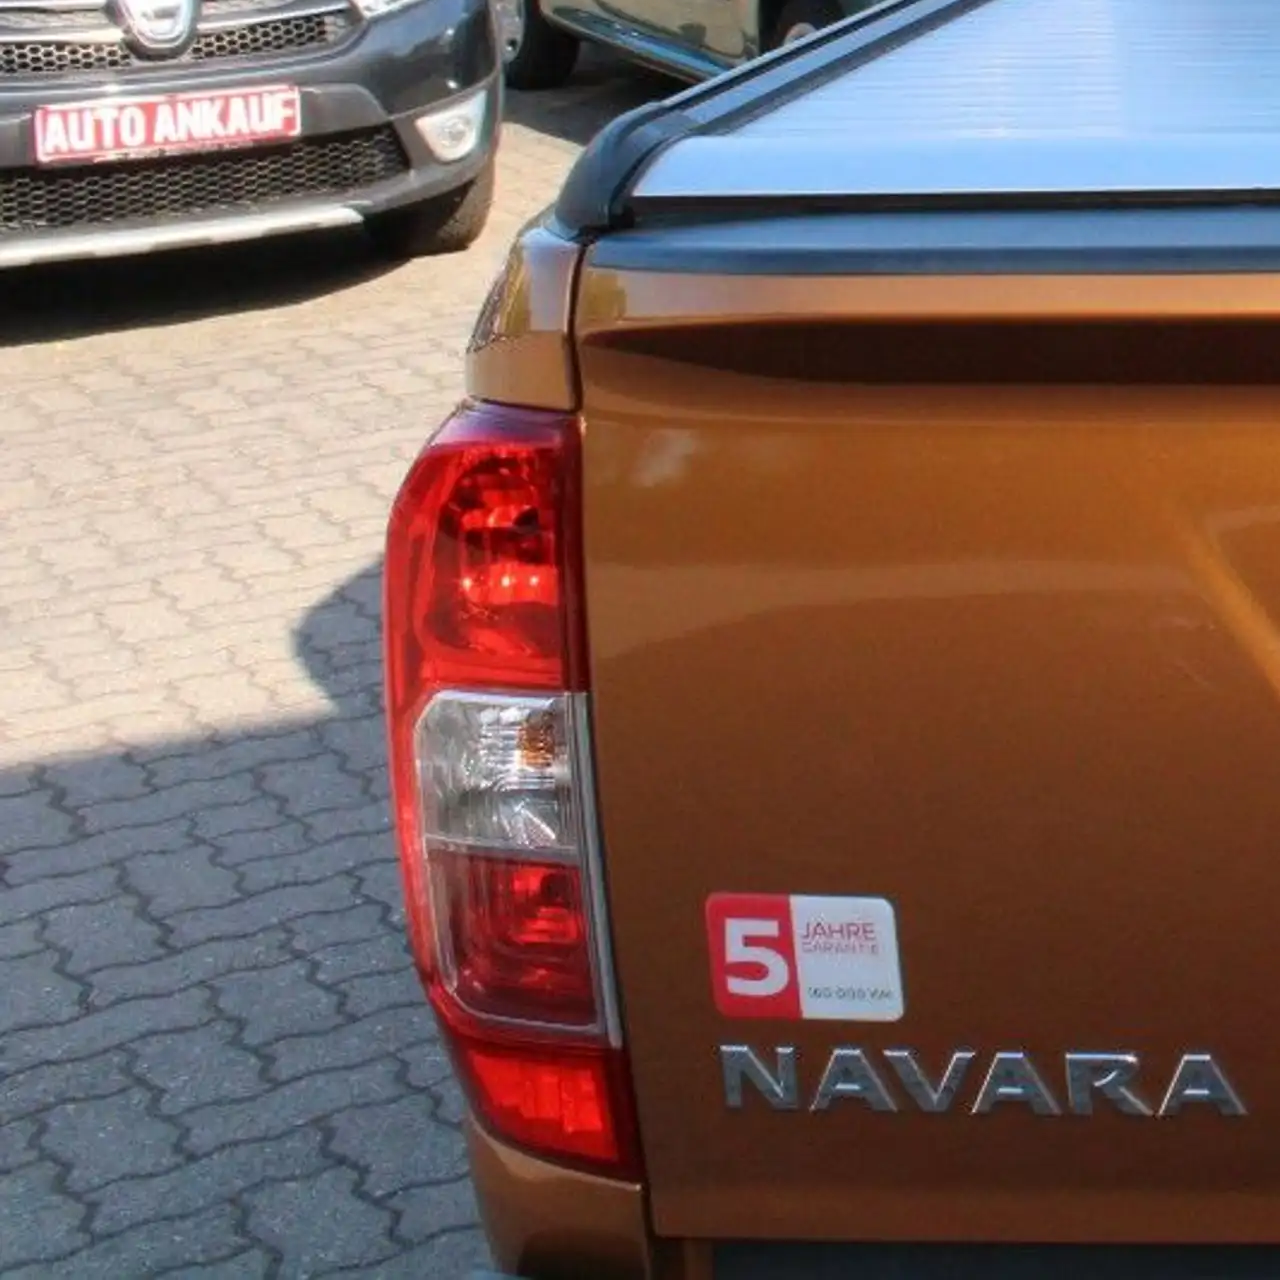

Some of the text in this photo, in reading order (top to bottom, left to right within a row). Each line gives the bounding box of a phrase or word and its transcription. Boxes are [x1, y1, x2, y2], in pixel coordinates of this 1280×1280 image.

[44, 92, 294, 152] AUTO ANKAUF
[724, 919, 790, 996] 5
[802, 922, 876, 941] JAHRE
[719, 1044, 1247, 1115] NAVARA
